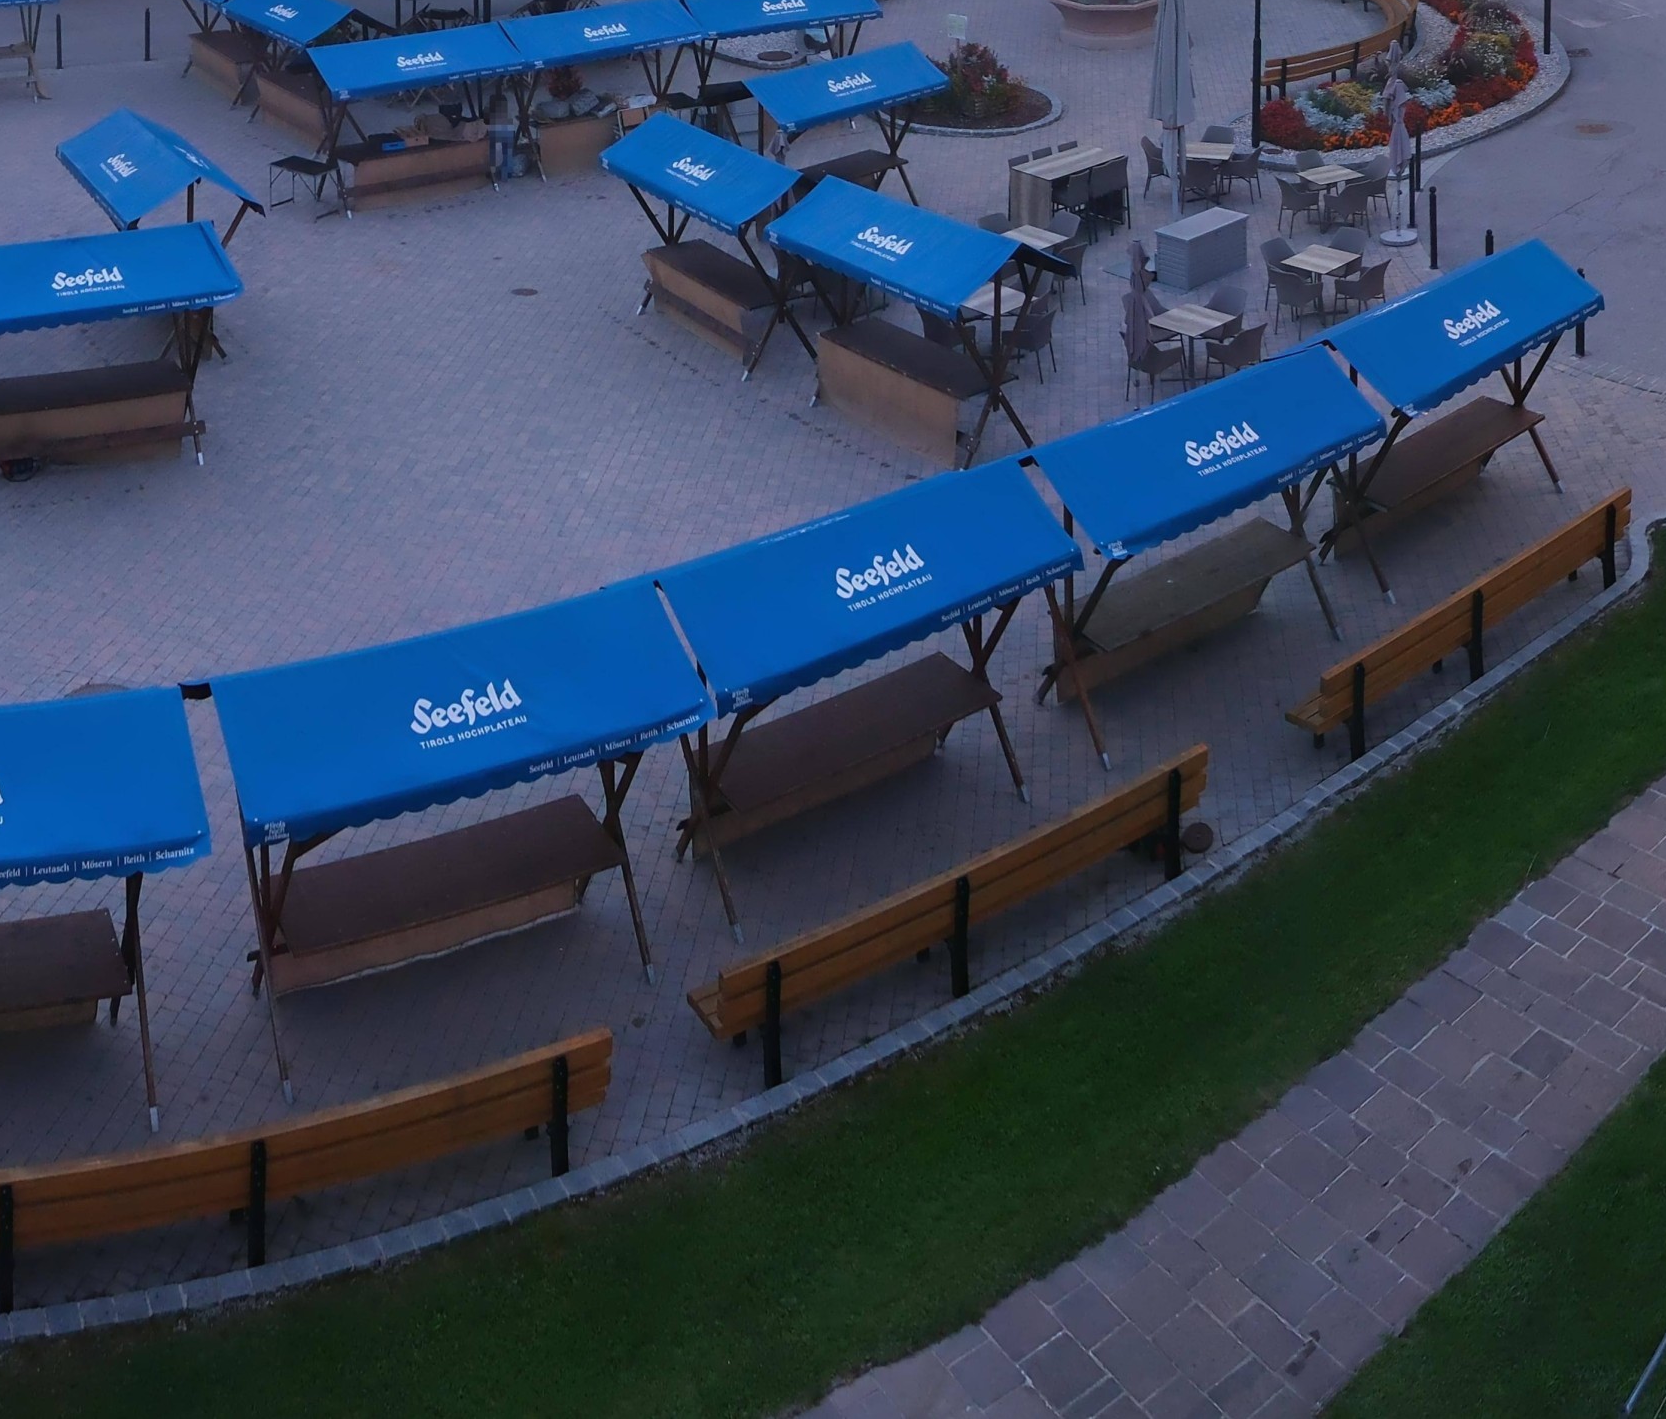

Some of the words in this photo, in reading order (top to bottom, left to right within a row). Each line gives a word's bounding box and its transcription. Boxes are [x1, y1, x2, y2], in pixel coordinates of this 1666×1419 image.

[582, 23, 627, 40] Seefeld
[396, 51, 445, 69] Seefeld
[827, 73, 872, 94] Seefeld
[107, 153, 137, 178] Seefeld
[671, 156, 718, 182] Seefeld
[856, 226, 916, 258] Seefeld
[51, 266, 124, 291] Seefeld
[56, 290, 78, 298] TIROLS
[1444, 300, 1501, 340] Seefeld
[1185, 421, 1261, 467] Seefeld
[1197, 462, 1222, 477] TIROLS
[1222, 445, 1268, 469] HOCHPLATEAU
[835, 543, 925, 599] Seefeld
[847, 595, 877, 613] TIROLS
[877, 573, 933, 601] HOCHPLATEAU
[410, 679, 523, 736] Seefeld
[420, 733, 455, 750] TIROLS
[456, 714, 528, 742] HOCHPLATEAU
[529, 758, 554, 775] Seefeld
[563, 747, 596, 766] Leutasch
[604, 736, 632, 753] Mösern
[639, 727, 659, 742] Reith
[666, 713, 700, 732] Scharnitz
[32, 862, 70, 877] Leutasch
[81, 856, 113, 870] Mösern
[123, 852, 146, 866] Reith
[155, 845, 195, 861] Scharnitz
